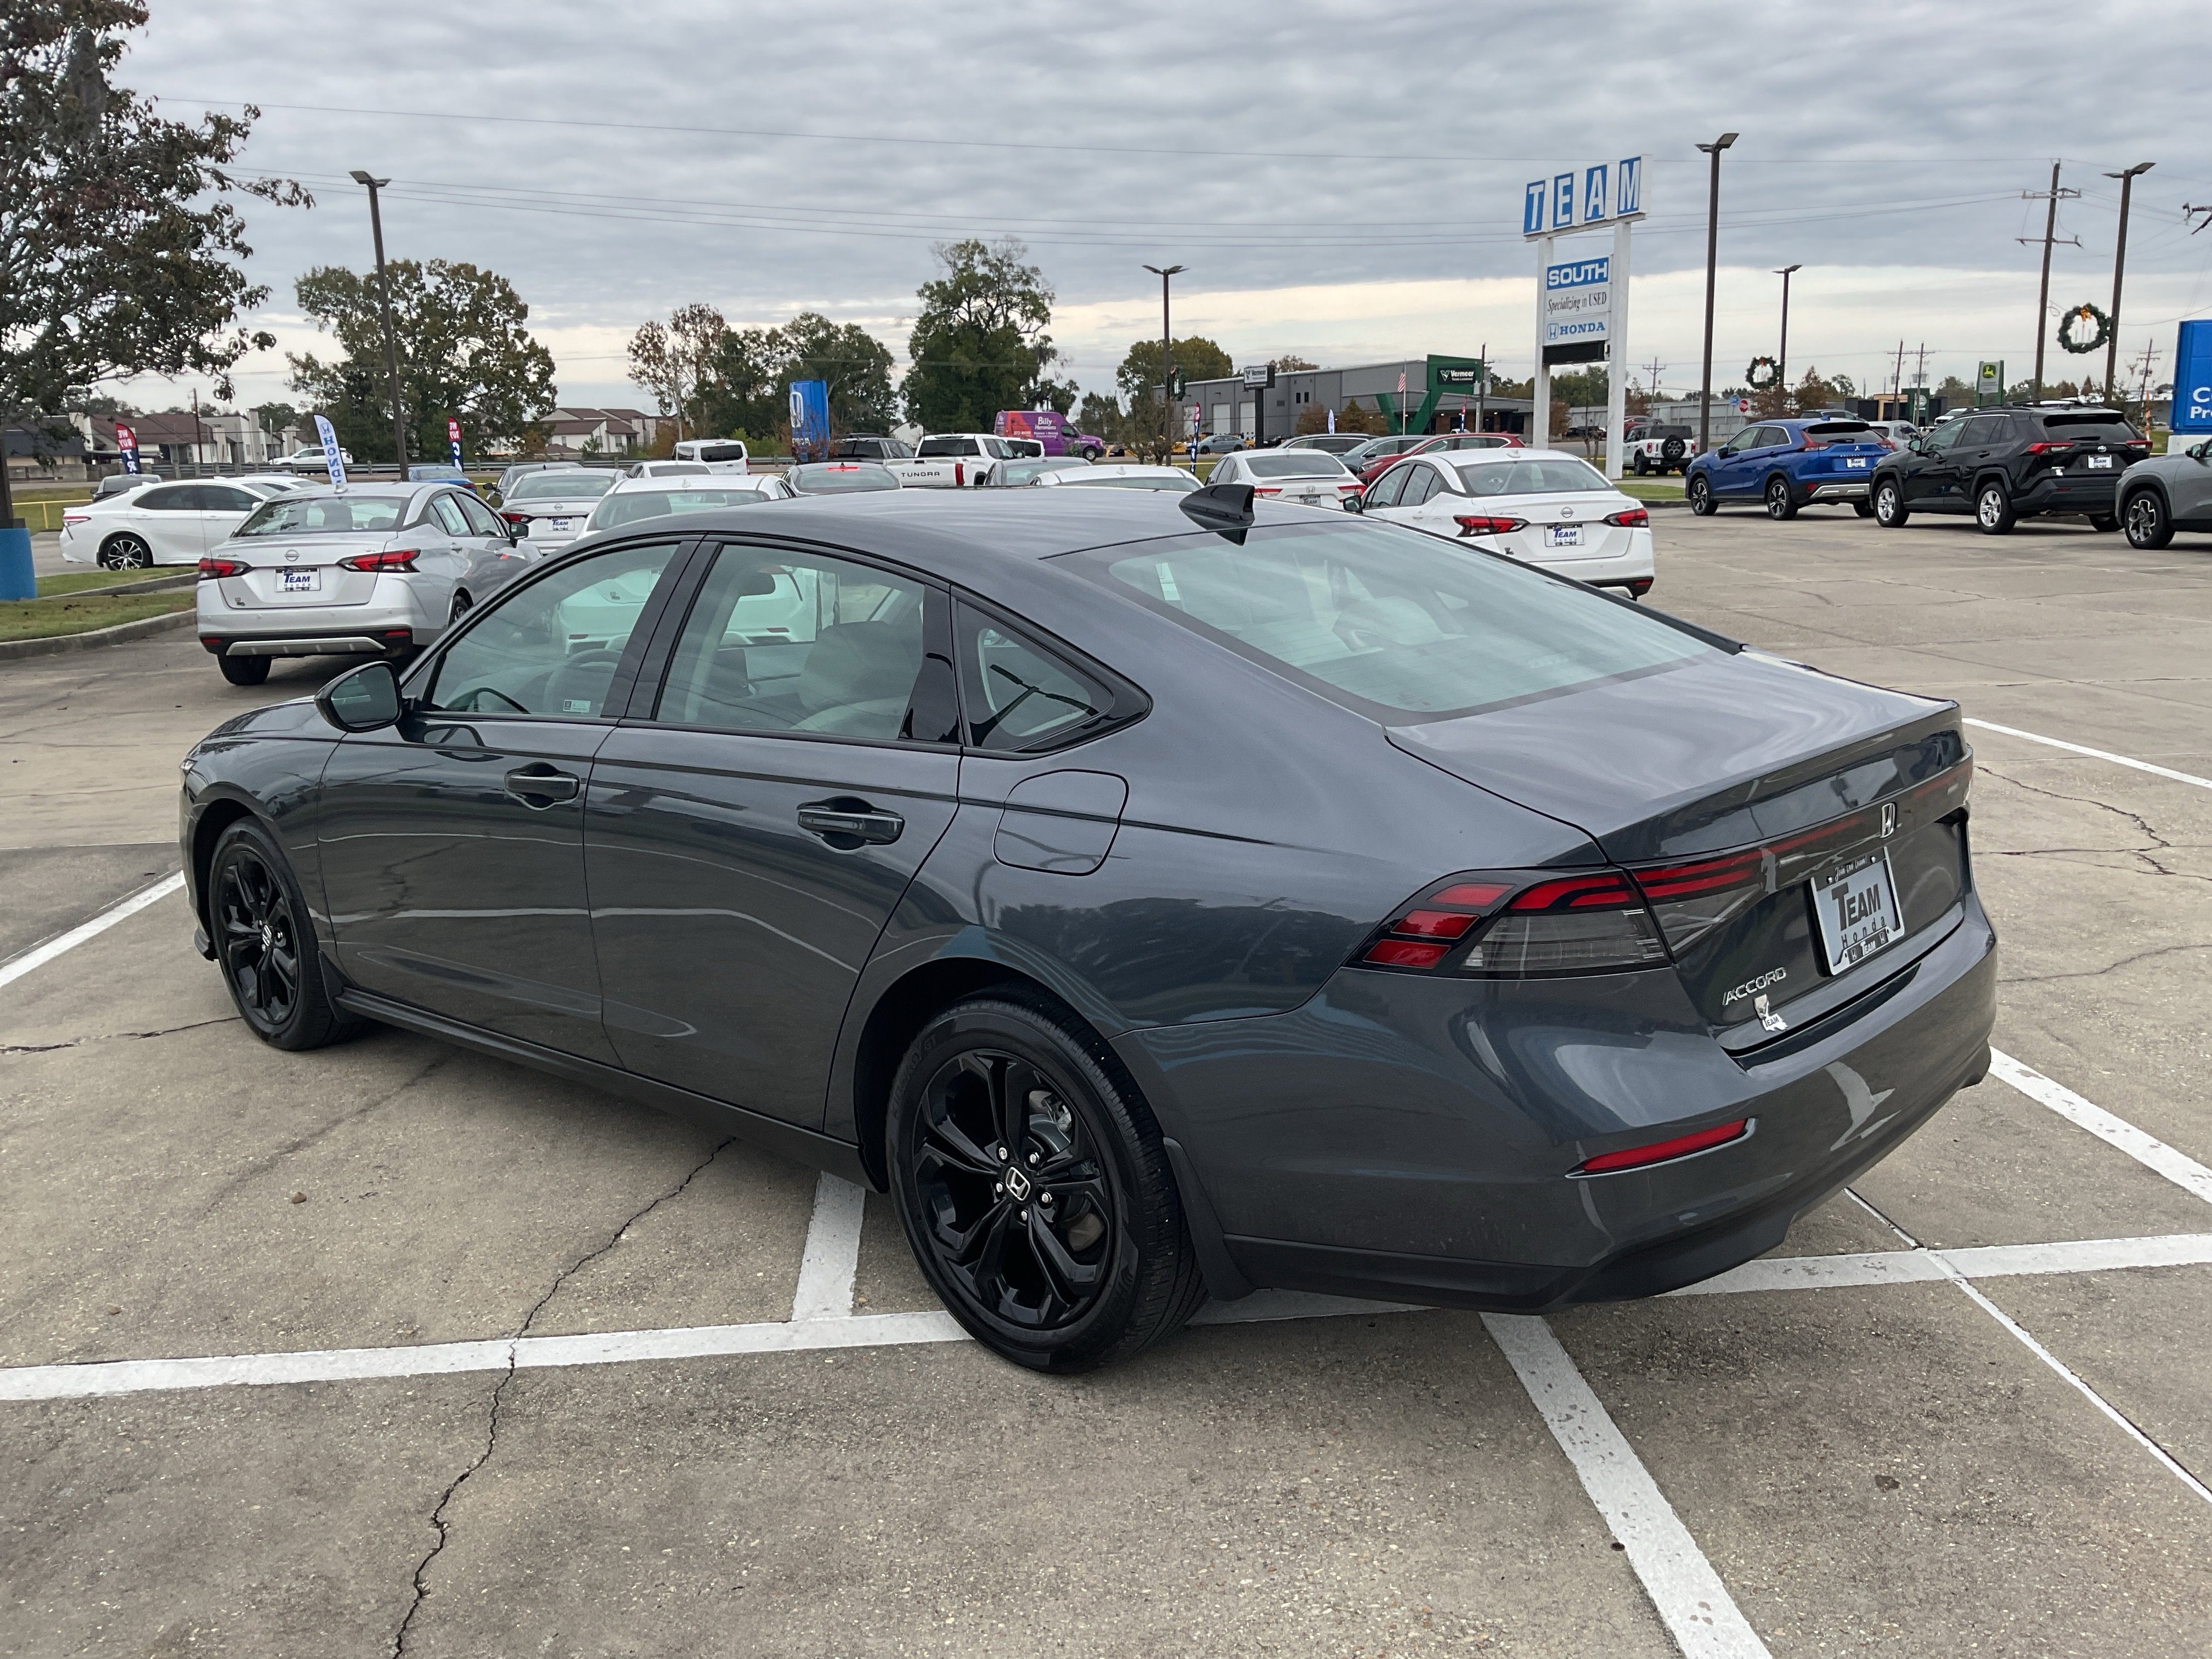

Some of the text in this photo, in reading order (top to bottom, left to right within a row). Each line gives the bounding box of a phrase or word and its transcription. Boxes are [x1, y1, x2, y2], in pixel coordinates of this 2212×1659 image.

[1528, 160, 1641, 230] TEAM
[1548, 262, 1607, 286] SOUTH
[1547, 292, 1607, 315] Specializing in USED
[1559, 322, 1605, 335] HONDA
[2193, 387, 2212, 403] C
[2190, 406, 2212, 419] Pr
[1038, 416, 1053, 427] Billy
[1554, 528, 1577, 538] TEAM
[284, 572, 311, 583] TEAM
[1831, 882, 1881, 932] TEAM
[1841, 916, 1885, 949] Honda
[1860, 940, 1876, 956] TEAM
[1722, 967, 1787, 1006] ACCORD
[1765, 1015, 1780, 1028] TEAM
